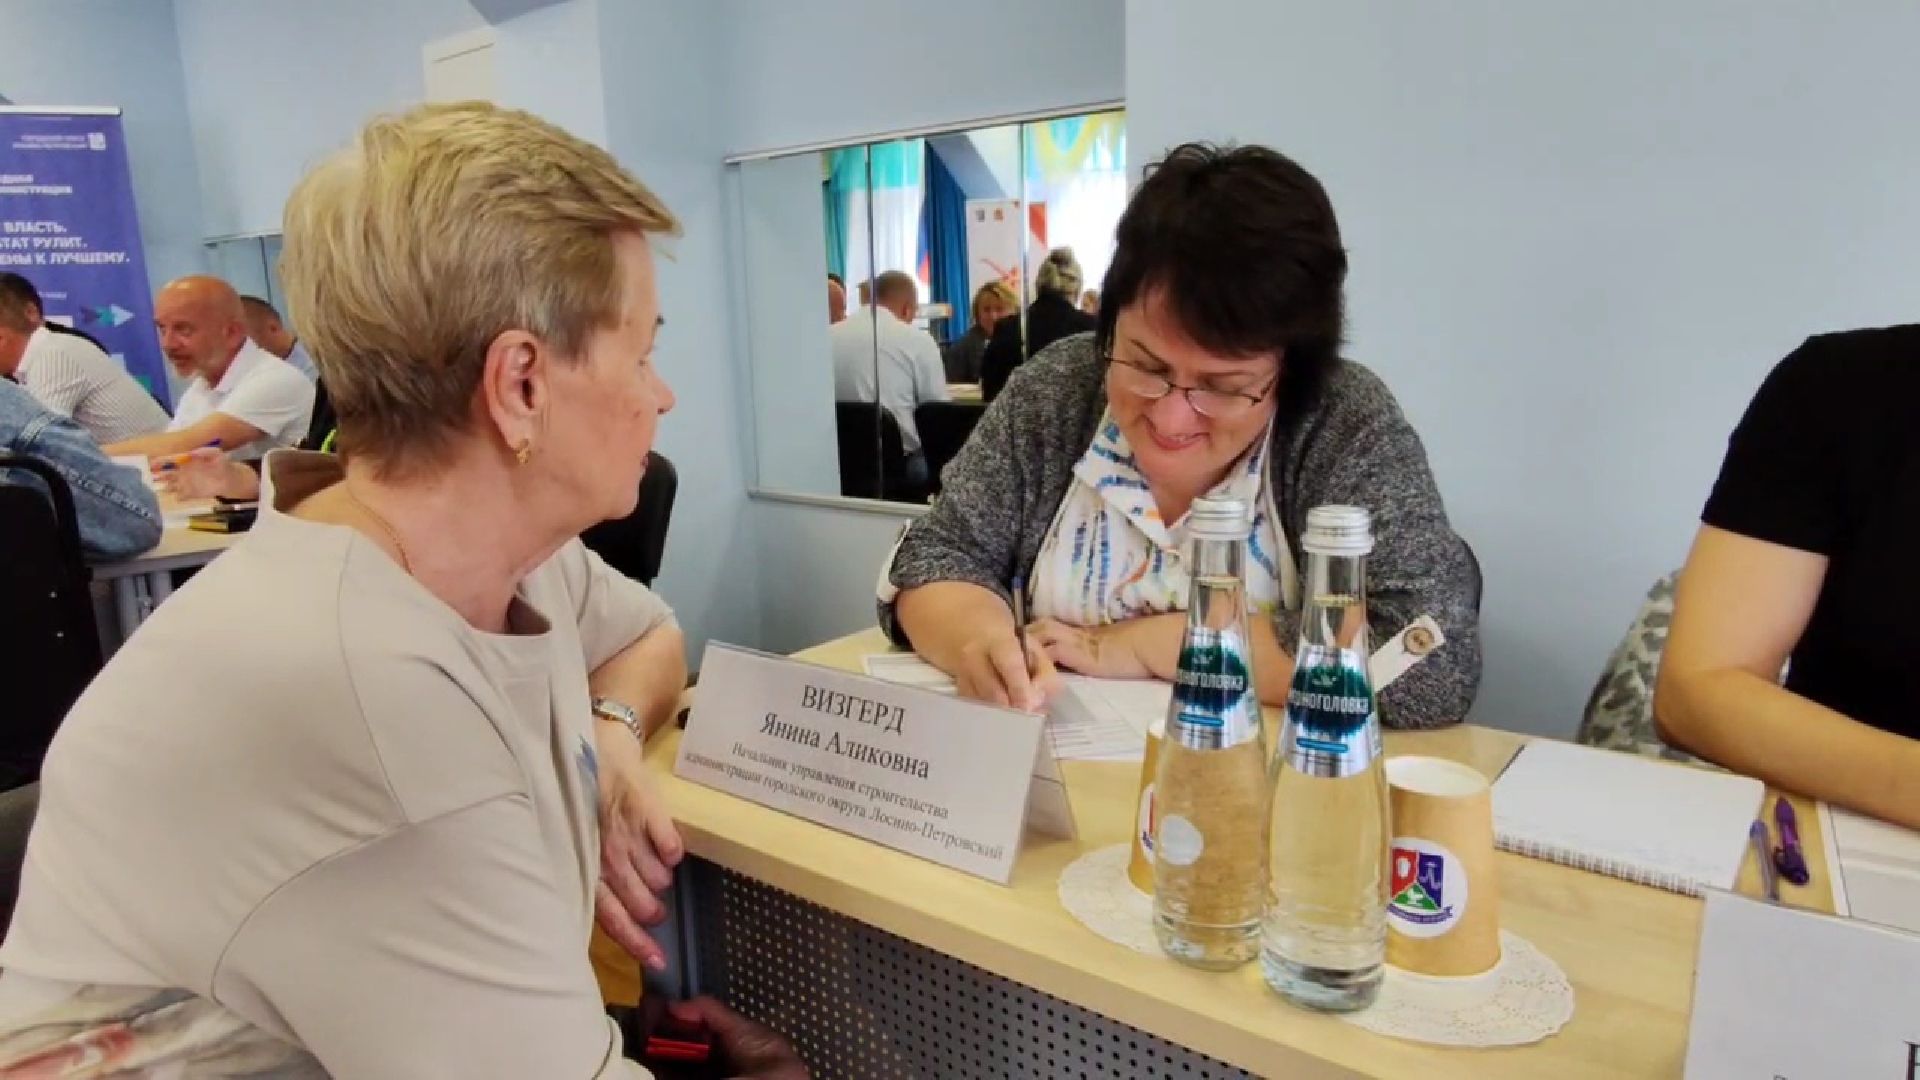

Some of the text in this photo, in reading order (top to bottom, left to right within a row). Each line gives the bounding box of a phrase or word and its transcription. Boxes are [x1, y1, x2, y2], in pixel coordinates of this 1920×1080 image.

[3, 221, 67, 233] ВЛАСТЬ.
[33, 236, 88, 248] РУЛИТ.
[0, 251, 130, 264] ЕНЫ К ЛУЧШЕМУ.
[801, 684, 906, 734] ВИЗГЕРД
[760, 711, 930, 779] Янина Аликовна
[731, 741, 950, 820] Начальник управления строительства
[762, 775, 826, 804] городского
[827, 796, 866, 818] округа
[868, 806, 1004, 861] Лосино-Петровский
